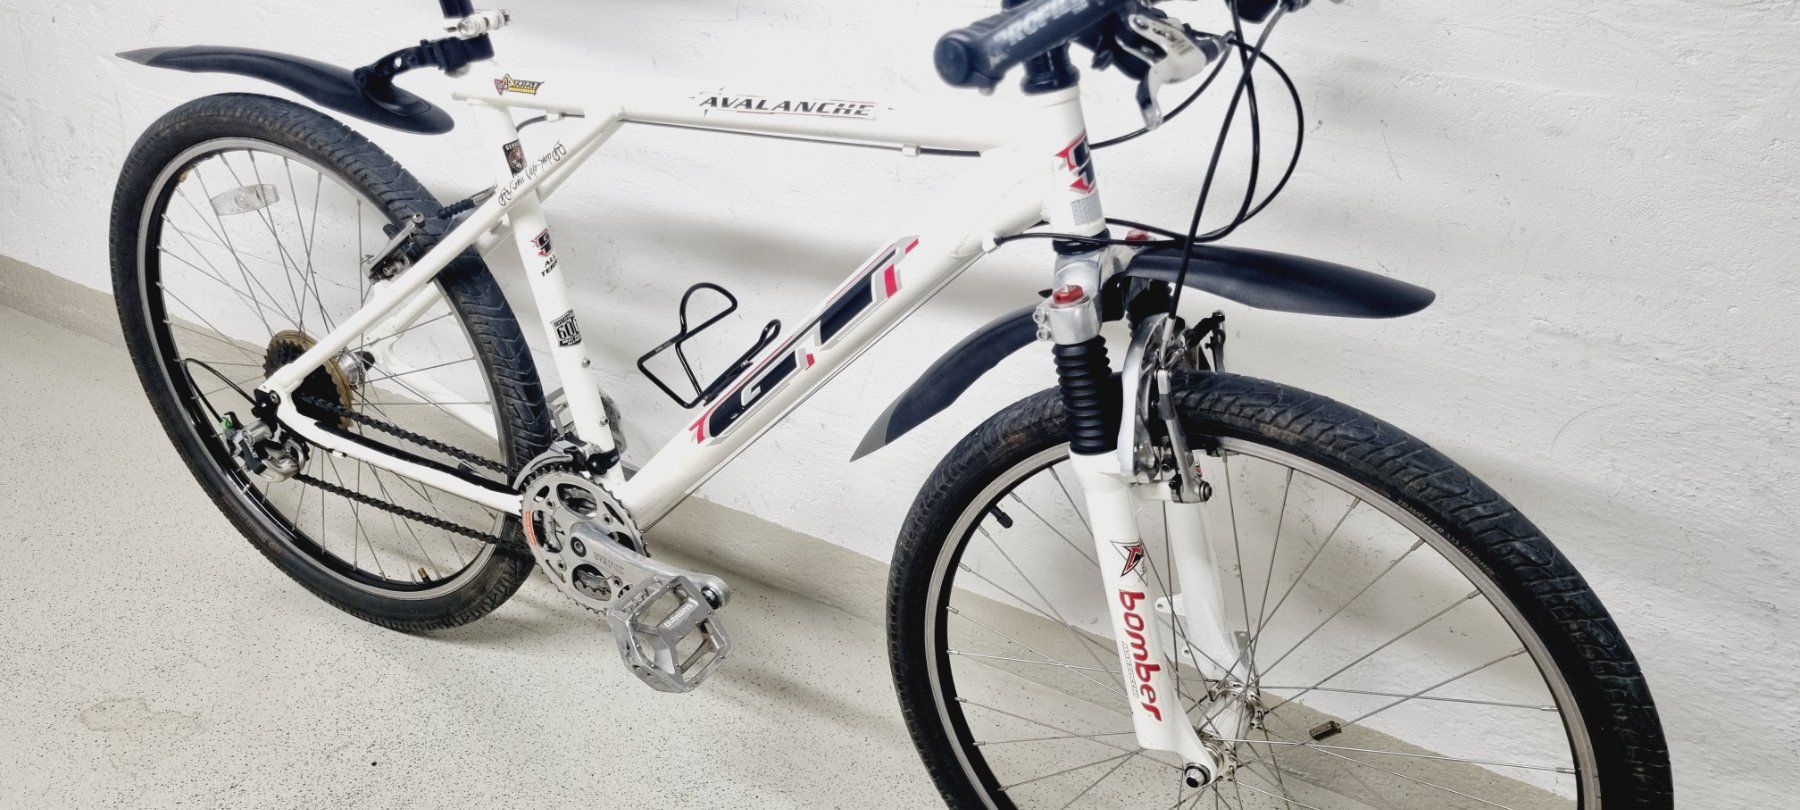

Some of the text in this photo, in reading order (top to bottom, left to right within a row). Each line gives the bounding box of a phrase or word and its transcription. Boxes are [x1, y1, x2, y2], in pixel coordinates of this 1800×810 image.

[699, 96, 874, 116] AVALANCHE
[1397, 499, 1445, 533] TRAVELLER
[1119, 589, 1161, 721] bomber
